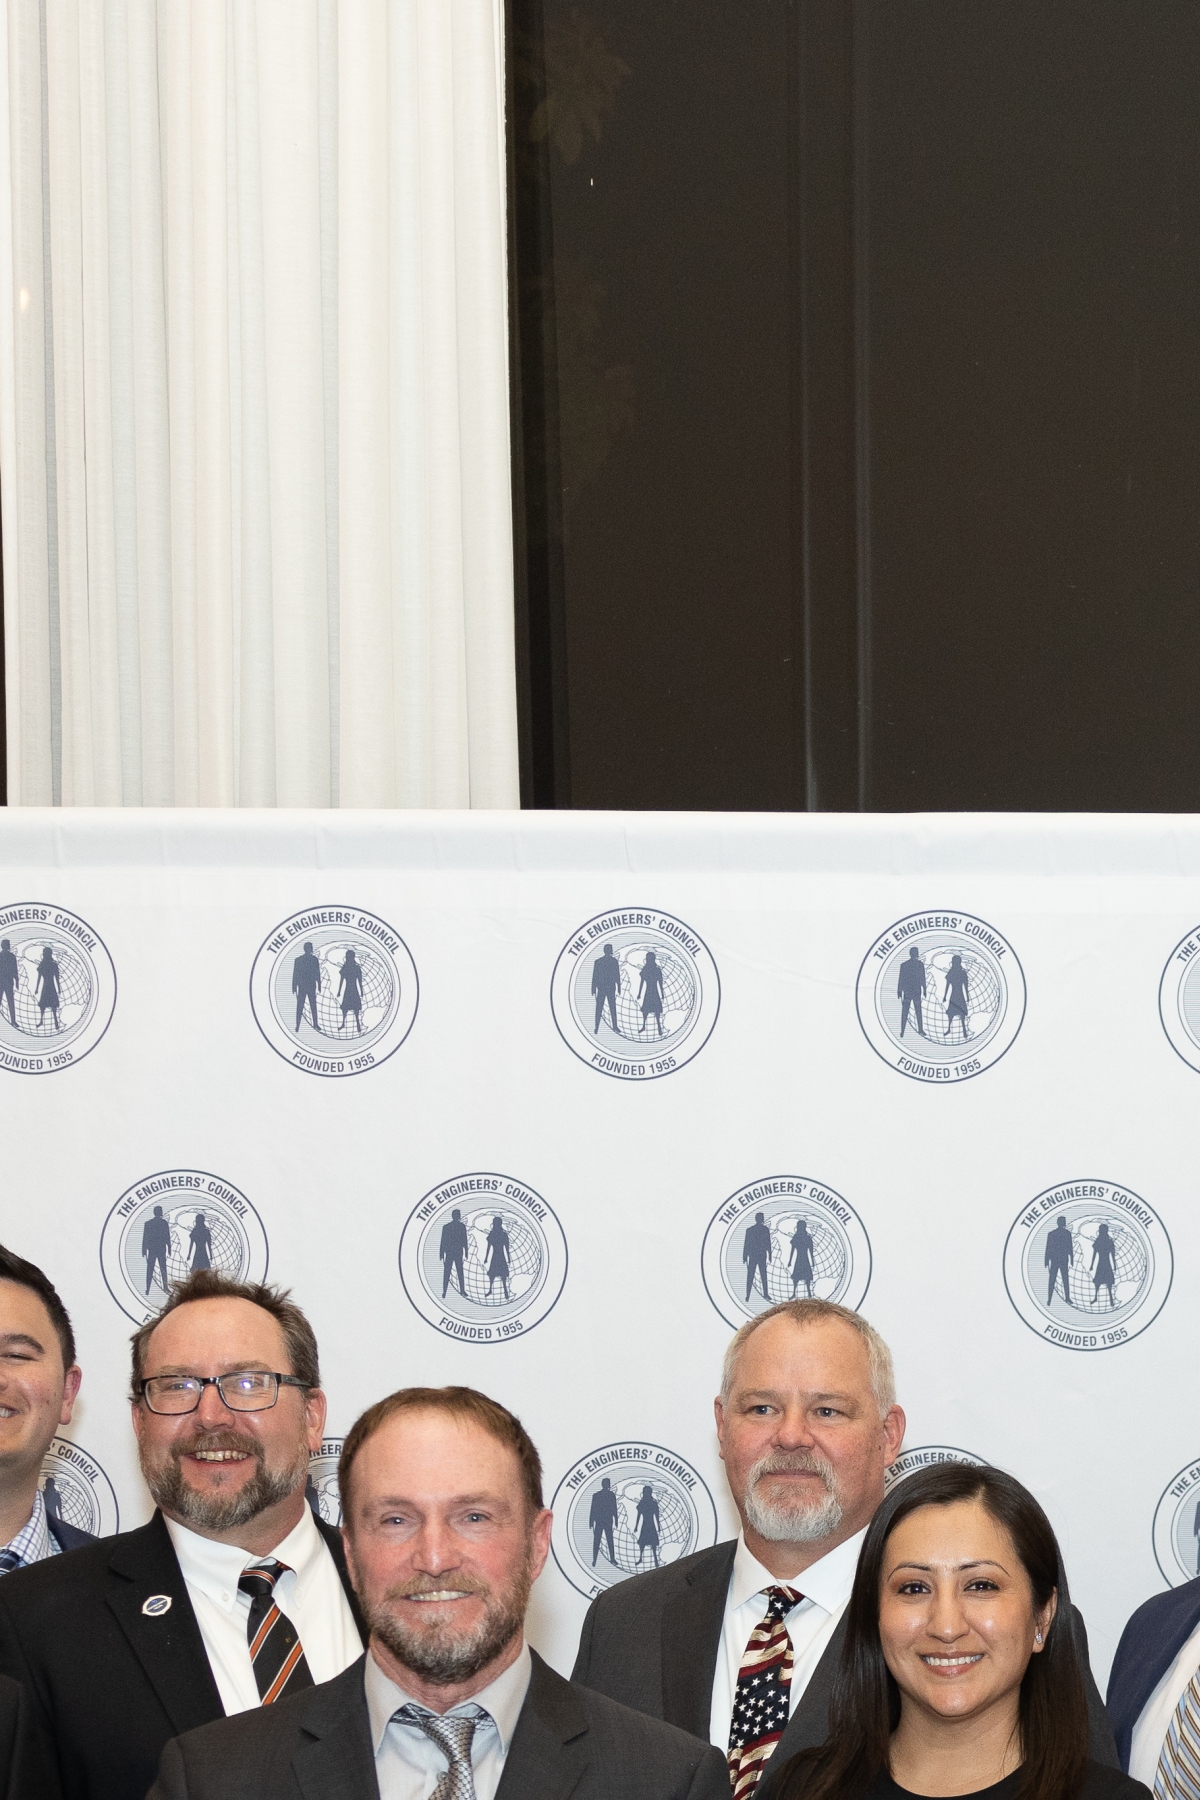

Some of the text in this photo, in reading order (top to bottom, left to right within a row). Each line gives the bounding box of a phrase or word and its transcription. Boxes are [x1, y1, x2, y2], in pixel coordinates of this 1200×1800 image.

[0, 908, 97, 953] GINEERS' COUNCIL
[266, 911, 400, 956] THE ENGINEERS' COUNCIL
[567, 913, 701, 958] THE ENGINEERS' COUNCIL
[873, 916, 1007, 960] THE ENGINEERS' COUNCIL
[1176, 940, 1198, 963] THE
[0, 1050, 74, 1071] OUNDED 1955
[292, 1050, 375, 1073] FOUNDED 1955
[591, 1052, 677, 1076] FOUNDED 1955
[896, 1056, 982, 1079] FOUNDED 1955
[116, 1175, 249, 1220] THE ENGINEERS' COUNCIL
[415, 1178, 548, 1223] THE ENGINEERS' COUNCIL
[718, 1181, 852, 1227] THE ENGINEERS' COUNCIL
[1020, 1185, 1154, 1230] THE ENGINEERS' COUNCIL
[438, 1316, 524, 1340] FOUNDED 1955
[1043, 1324, 1129, 1347] FOUNDED 1955
[57, 1444, 100, 1484] COUNCIL
[565, 1447, 697, 1492] THE ENGINEERS' COUNCIL
[1169, 1476, 1192, 1498] THE
